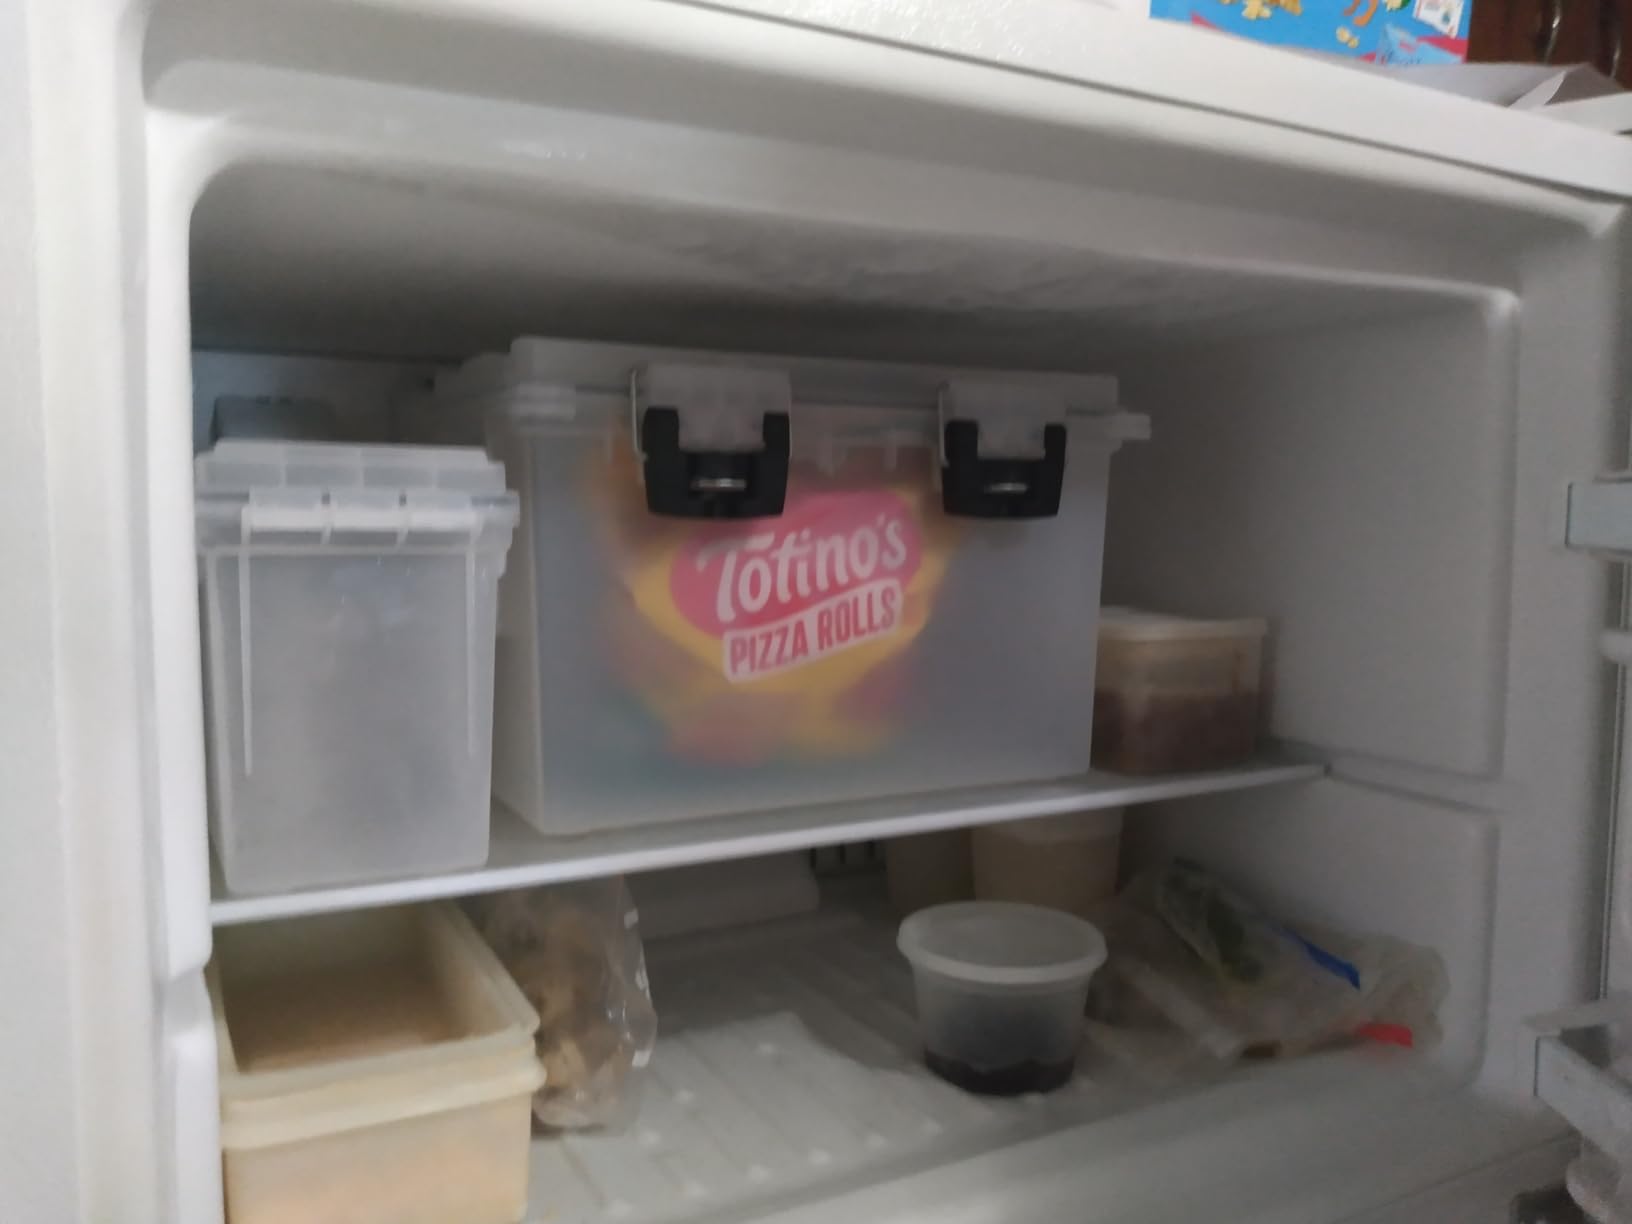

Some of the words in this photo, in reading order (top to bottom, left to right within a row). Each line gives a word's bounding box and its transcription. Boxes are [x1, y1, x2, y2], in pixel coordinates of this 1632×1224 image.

[694, 513, 906, 622] Totino's
[730, 619, 808, 673] PIZZA
[817, 587, 896, 651] ROLLS
